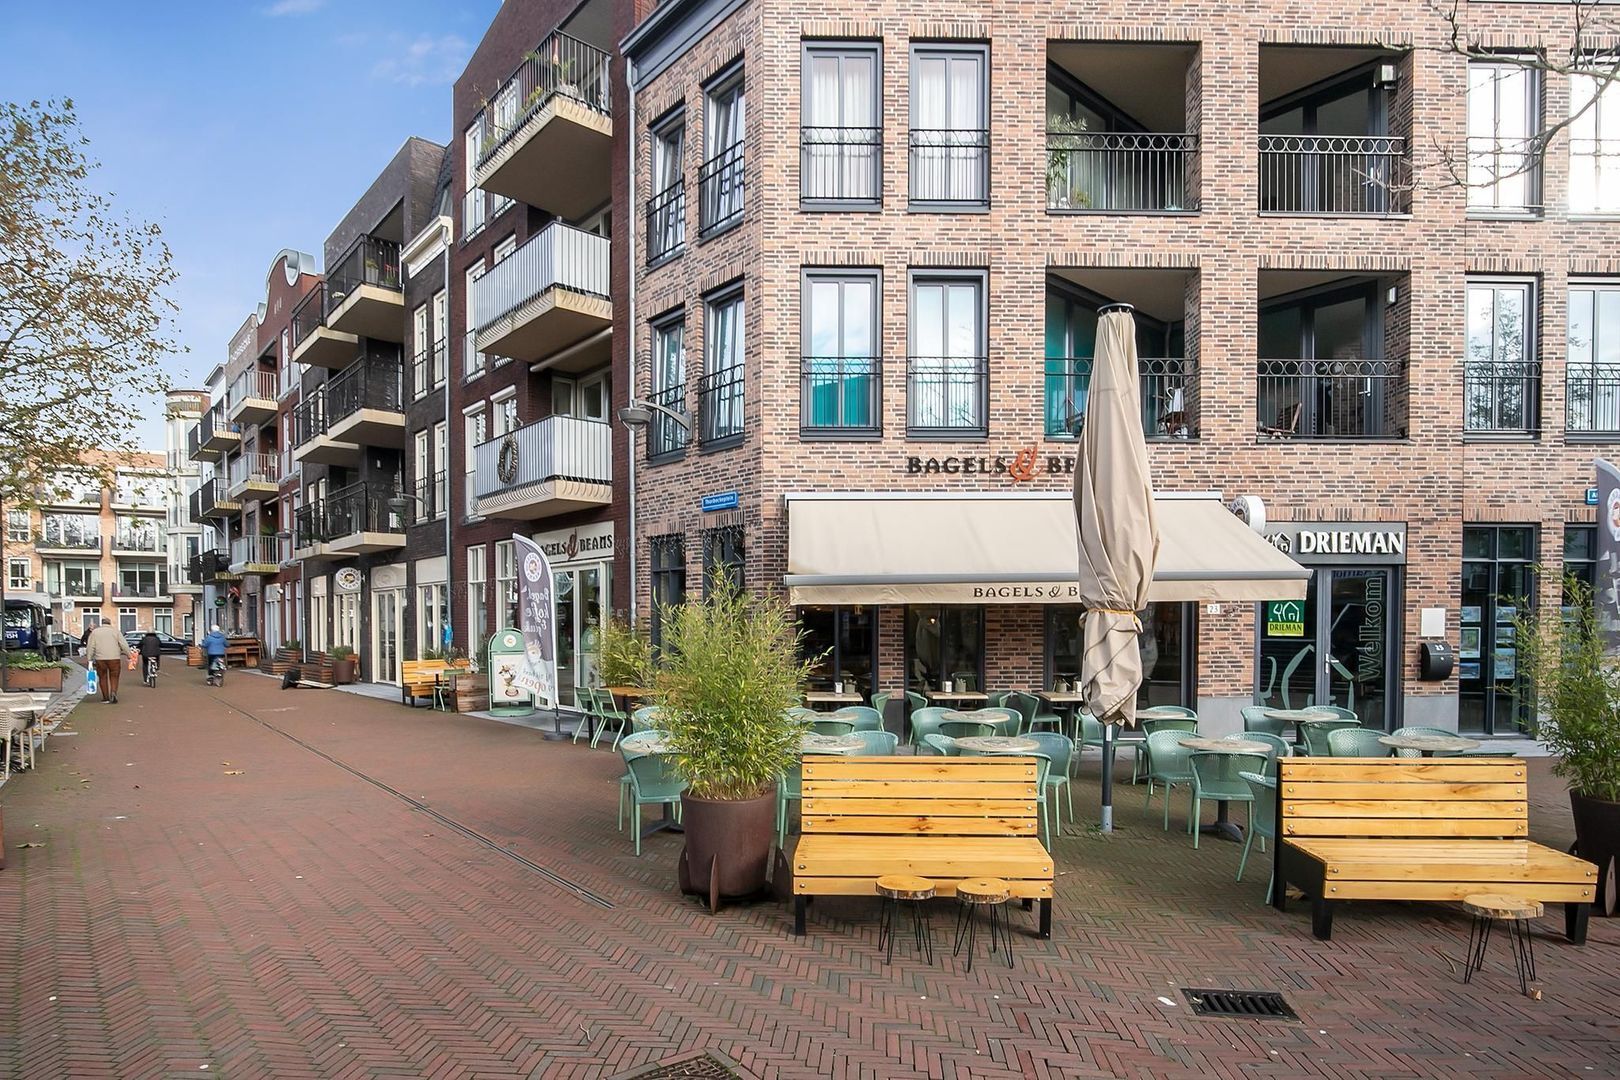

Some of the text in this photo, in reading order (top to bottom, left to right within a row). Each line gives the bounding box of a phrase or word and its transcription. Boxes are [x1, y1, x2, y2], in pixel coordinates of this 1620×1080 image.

[907, 456, 1006, 474] BAGELS
[540, 541, 567, 557] AGELS
[579, 534, 613, 552] BEANS
[1299, 530, 1405, 554] DRIEMAN
[973, 586, 1044, 598] BAGELS
[1048, 584, 1063, 598] &
[1209, 605, 1219, 613] 23
[1269, 623, 1303, 632] DRIEMAN
[1358, 576, 1383, 683] Welkom
